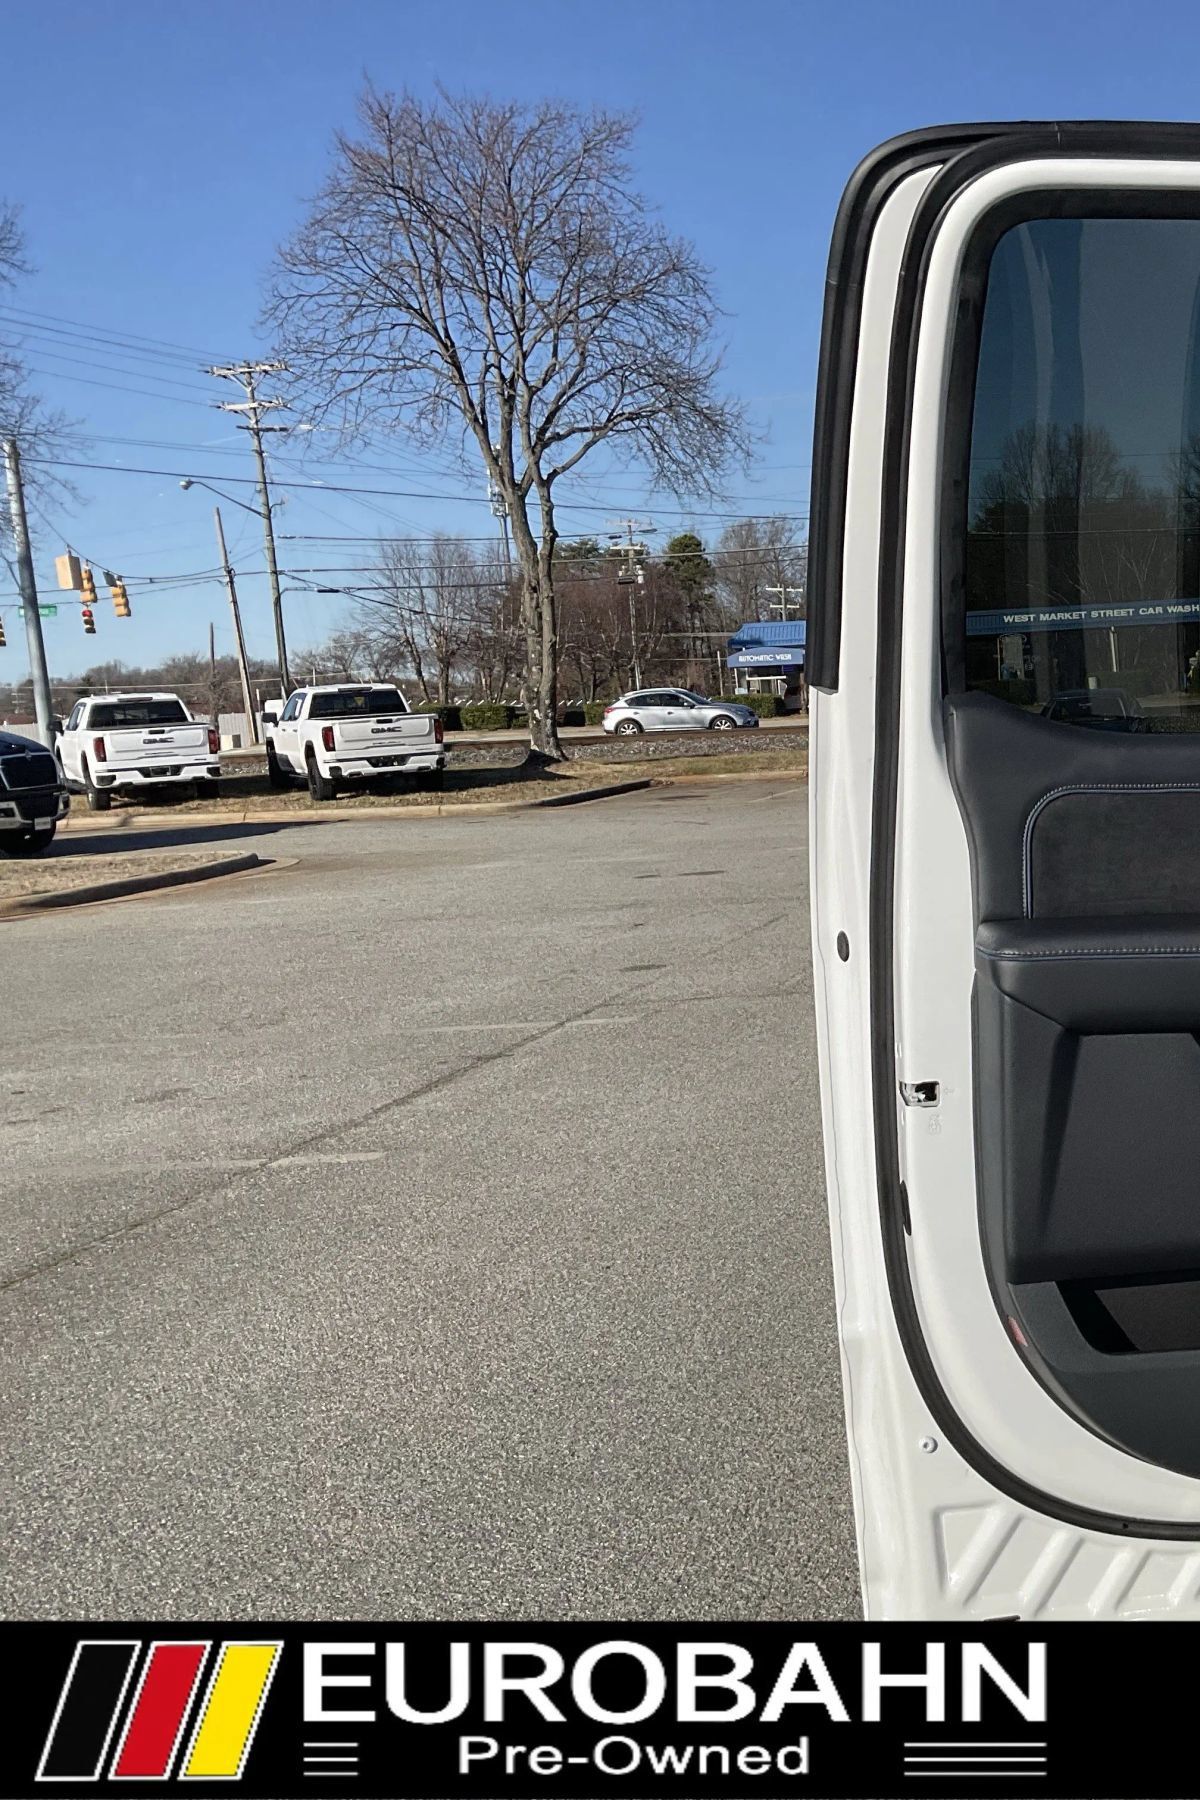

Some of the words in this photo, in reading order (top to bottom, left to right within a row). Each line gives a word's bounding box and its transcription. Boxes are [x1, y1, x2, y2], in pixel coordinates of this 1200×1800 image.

[1003, 614, 1035, 623] WEST
[1039, 611, 1087, 621] MARKET
[1090, 608, 1135, 618] STREET
[1138, 606, 1164, 615] CAR
[1166, 603, 1200, 613] WASH
[371, 726, 403, 734] GMC
[142, 736, 175, 745] GMC
